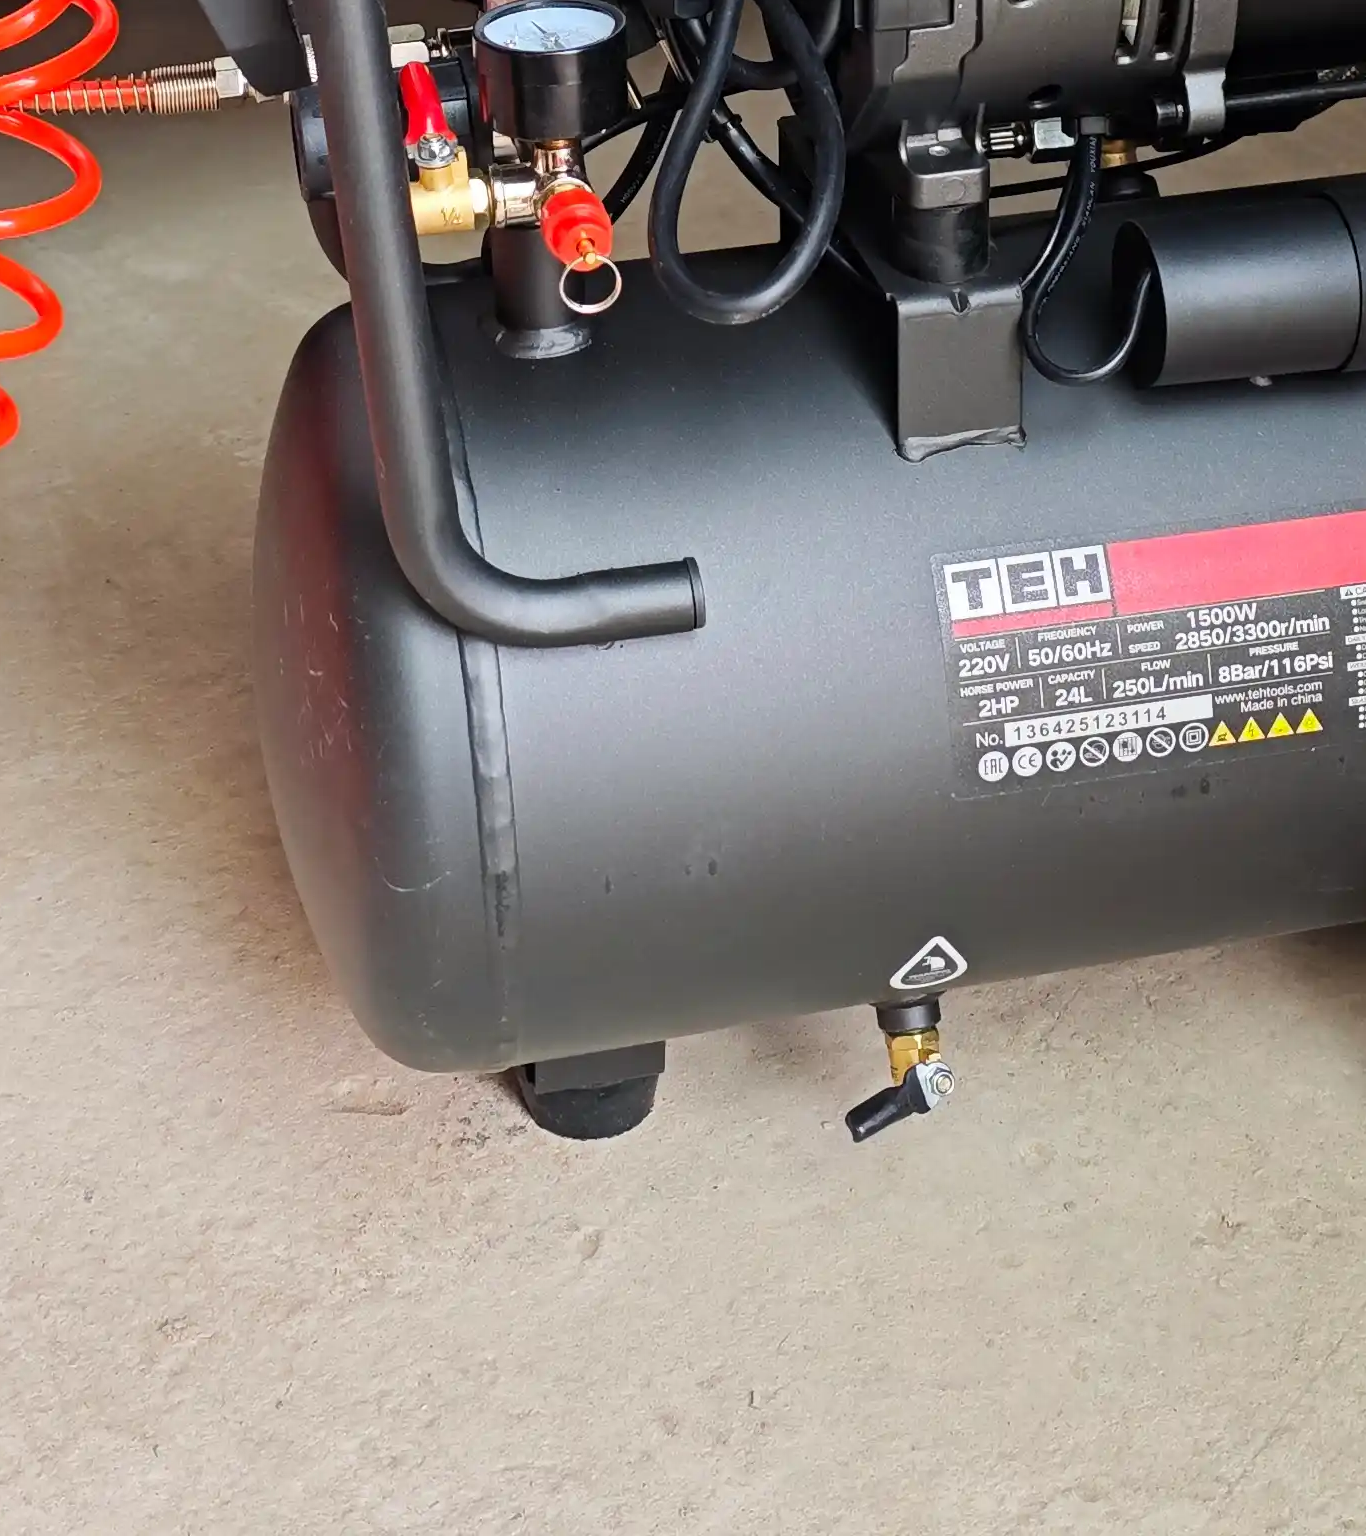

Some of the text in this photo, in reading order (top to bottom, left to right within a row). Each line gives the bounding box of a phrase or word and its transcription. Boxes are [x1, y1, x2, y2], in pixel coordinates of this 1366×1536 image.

[949, 551, 1106, 612] TEH
[1126, 601, 1258, 634] POWER 1500W
[959, 636, 1006, 655] VOLTAGE
[1037, 623, 1097, 644] FREQUENCY
[1127, 612, 1330, 655] SPEED 2850/3300r/min
[1027, 638, 1113, 667] 50/60Hz
[1248, 639, 1300, 658] PRESSURE
[957, 651, 1011, 679] 220V
[1047, 668, 1096, 686] CAPACITY
[1140, 658, 1172, 673] FLOW
[1216, 650, 1334, 684] 8Bar/116Psi
[959, 677, 1034, 698] HORSE POWER
[1053, 683, 1093, 707] 24L
[1110, 669, 1204, 699] 250L/min
[1214, 679, 1323, 705] www.tehtools.com
[977, 693, 1021, 718] 2HP
[1239, 690, 1323, 713] Made in china
[975, 704, 1168, 749] No. 136425123114
